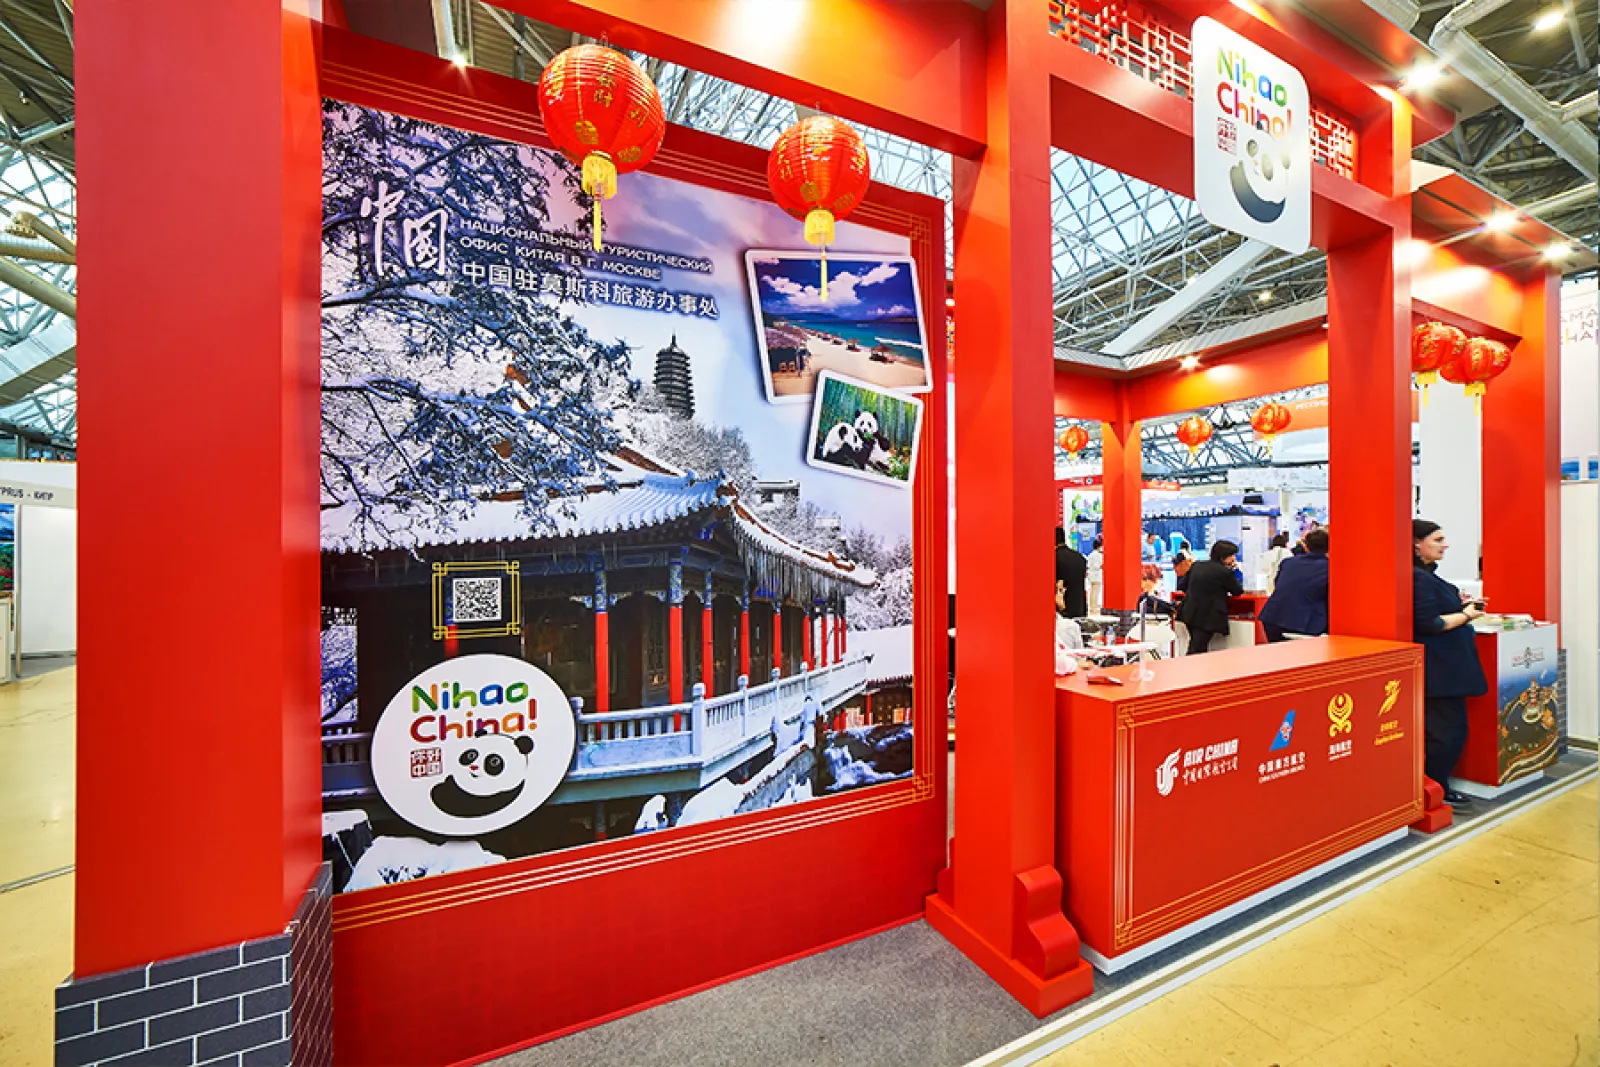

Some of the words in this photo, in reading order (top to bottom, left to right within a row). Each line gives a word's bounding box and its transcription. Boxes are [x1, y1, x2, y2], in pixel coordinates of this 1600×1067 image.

[1217, 46, 1288, 108] Nihao
[460, 218, 593, 252] НАЦИОНАЛЬНЫЙ
[460, 236, 509, 254] ОФИС
[515, 246, 566, 265] КИТАЯ
[571, 255, 582, 266] В
[602, 260, 661, 280] МОСКВЕ
[461, 261, 719, 318] 中国驻莫斯科旅游办事处
[411, 682, 529, 713] Nihao
[410, 698, 538, 743] China!
[1183, 748, 1204, 767] AIR
[1205, 738, 1239, 761] CHINA
